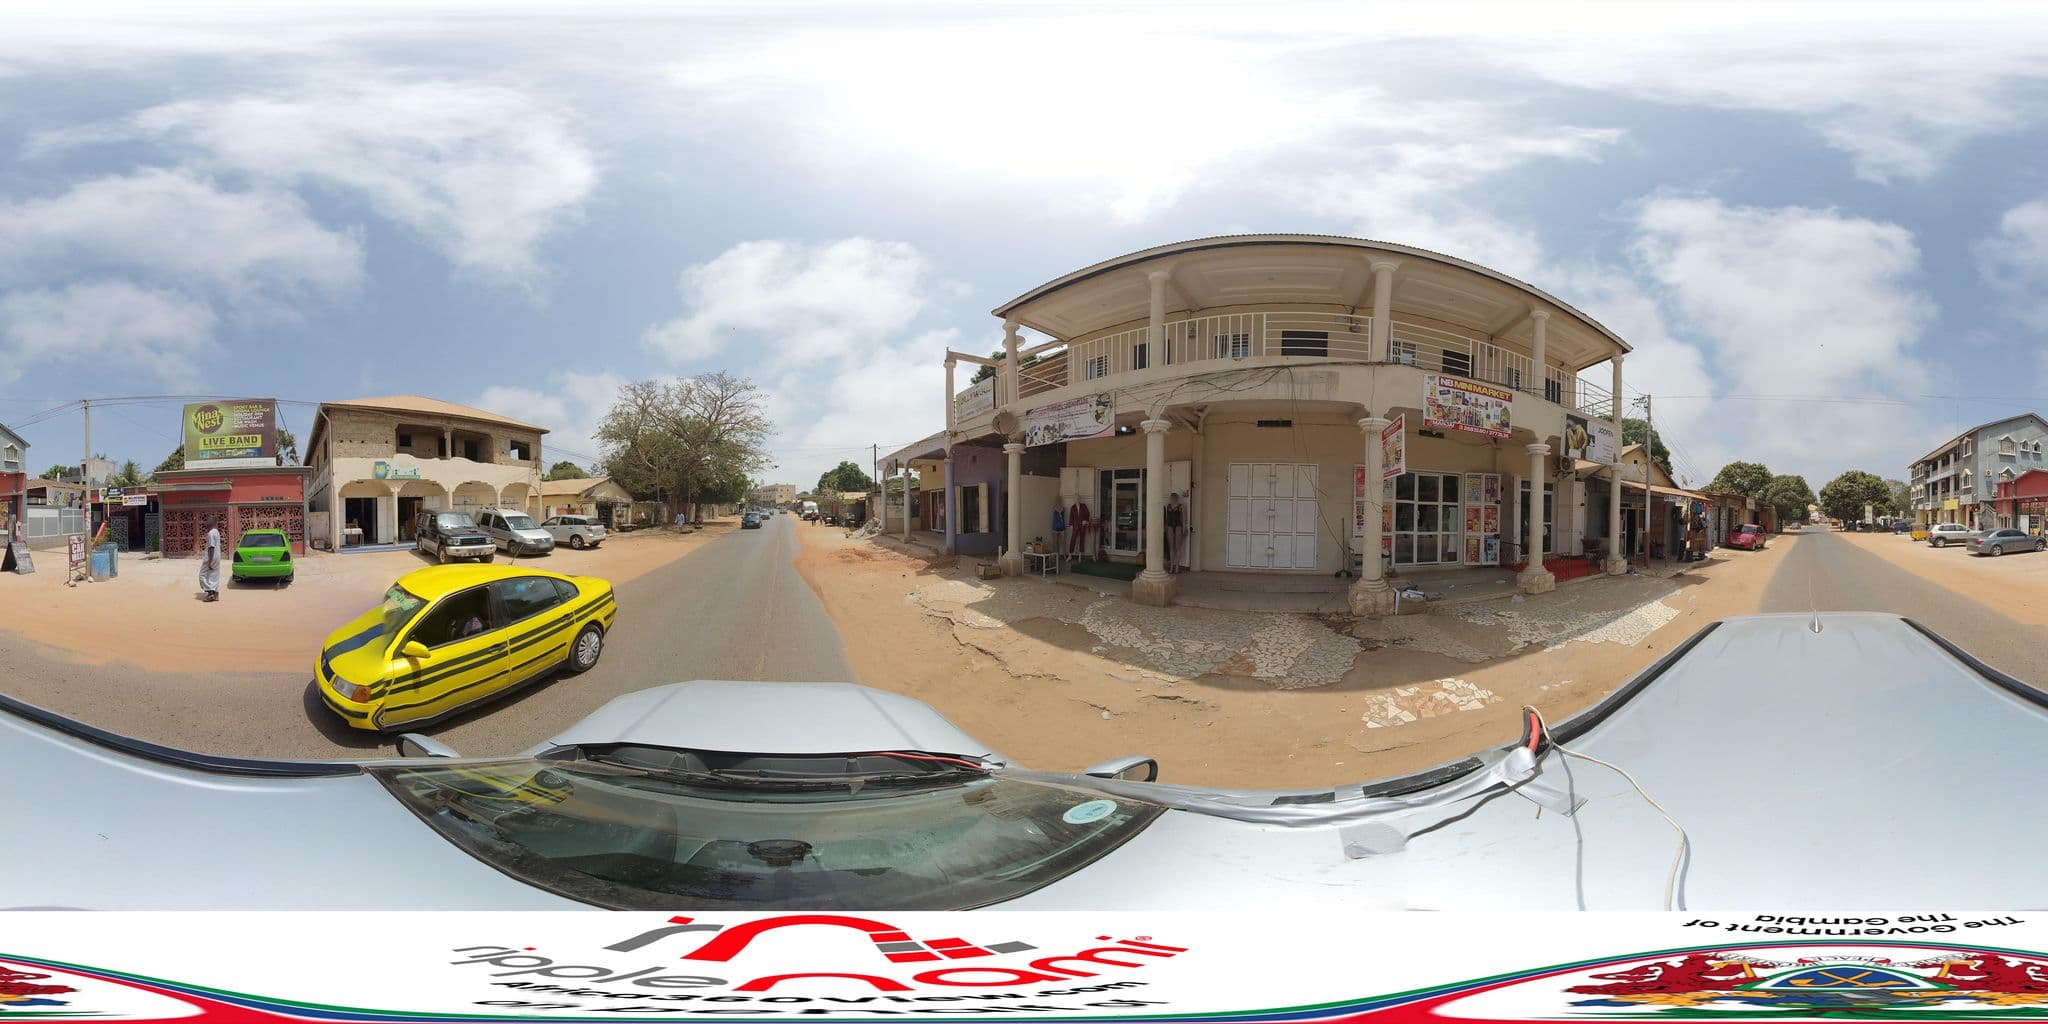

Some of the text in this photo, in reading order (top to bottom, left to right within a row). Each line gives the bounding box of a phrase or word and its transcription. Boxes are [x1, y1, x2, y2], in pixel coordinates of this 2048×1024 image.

[1473, 384, 1511, 400] MARKET
[197, 416, 221, 430] Nest
[203, 436, 258, 446] LIVE BAND
